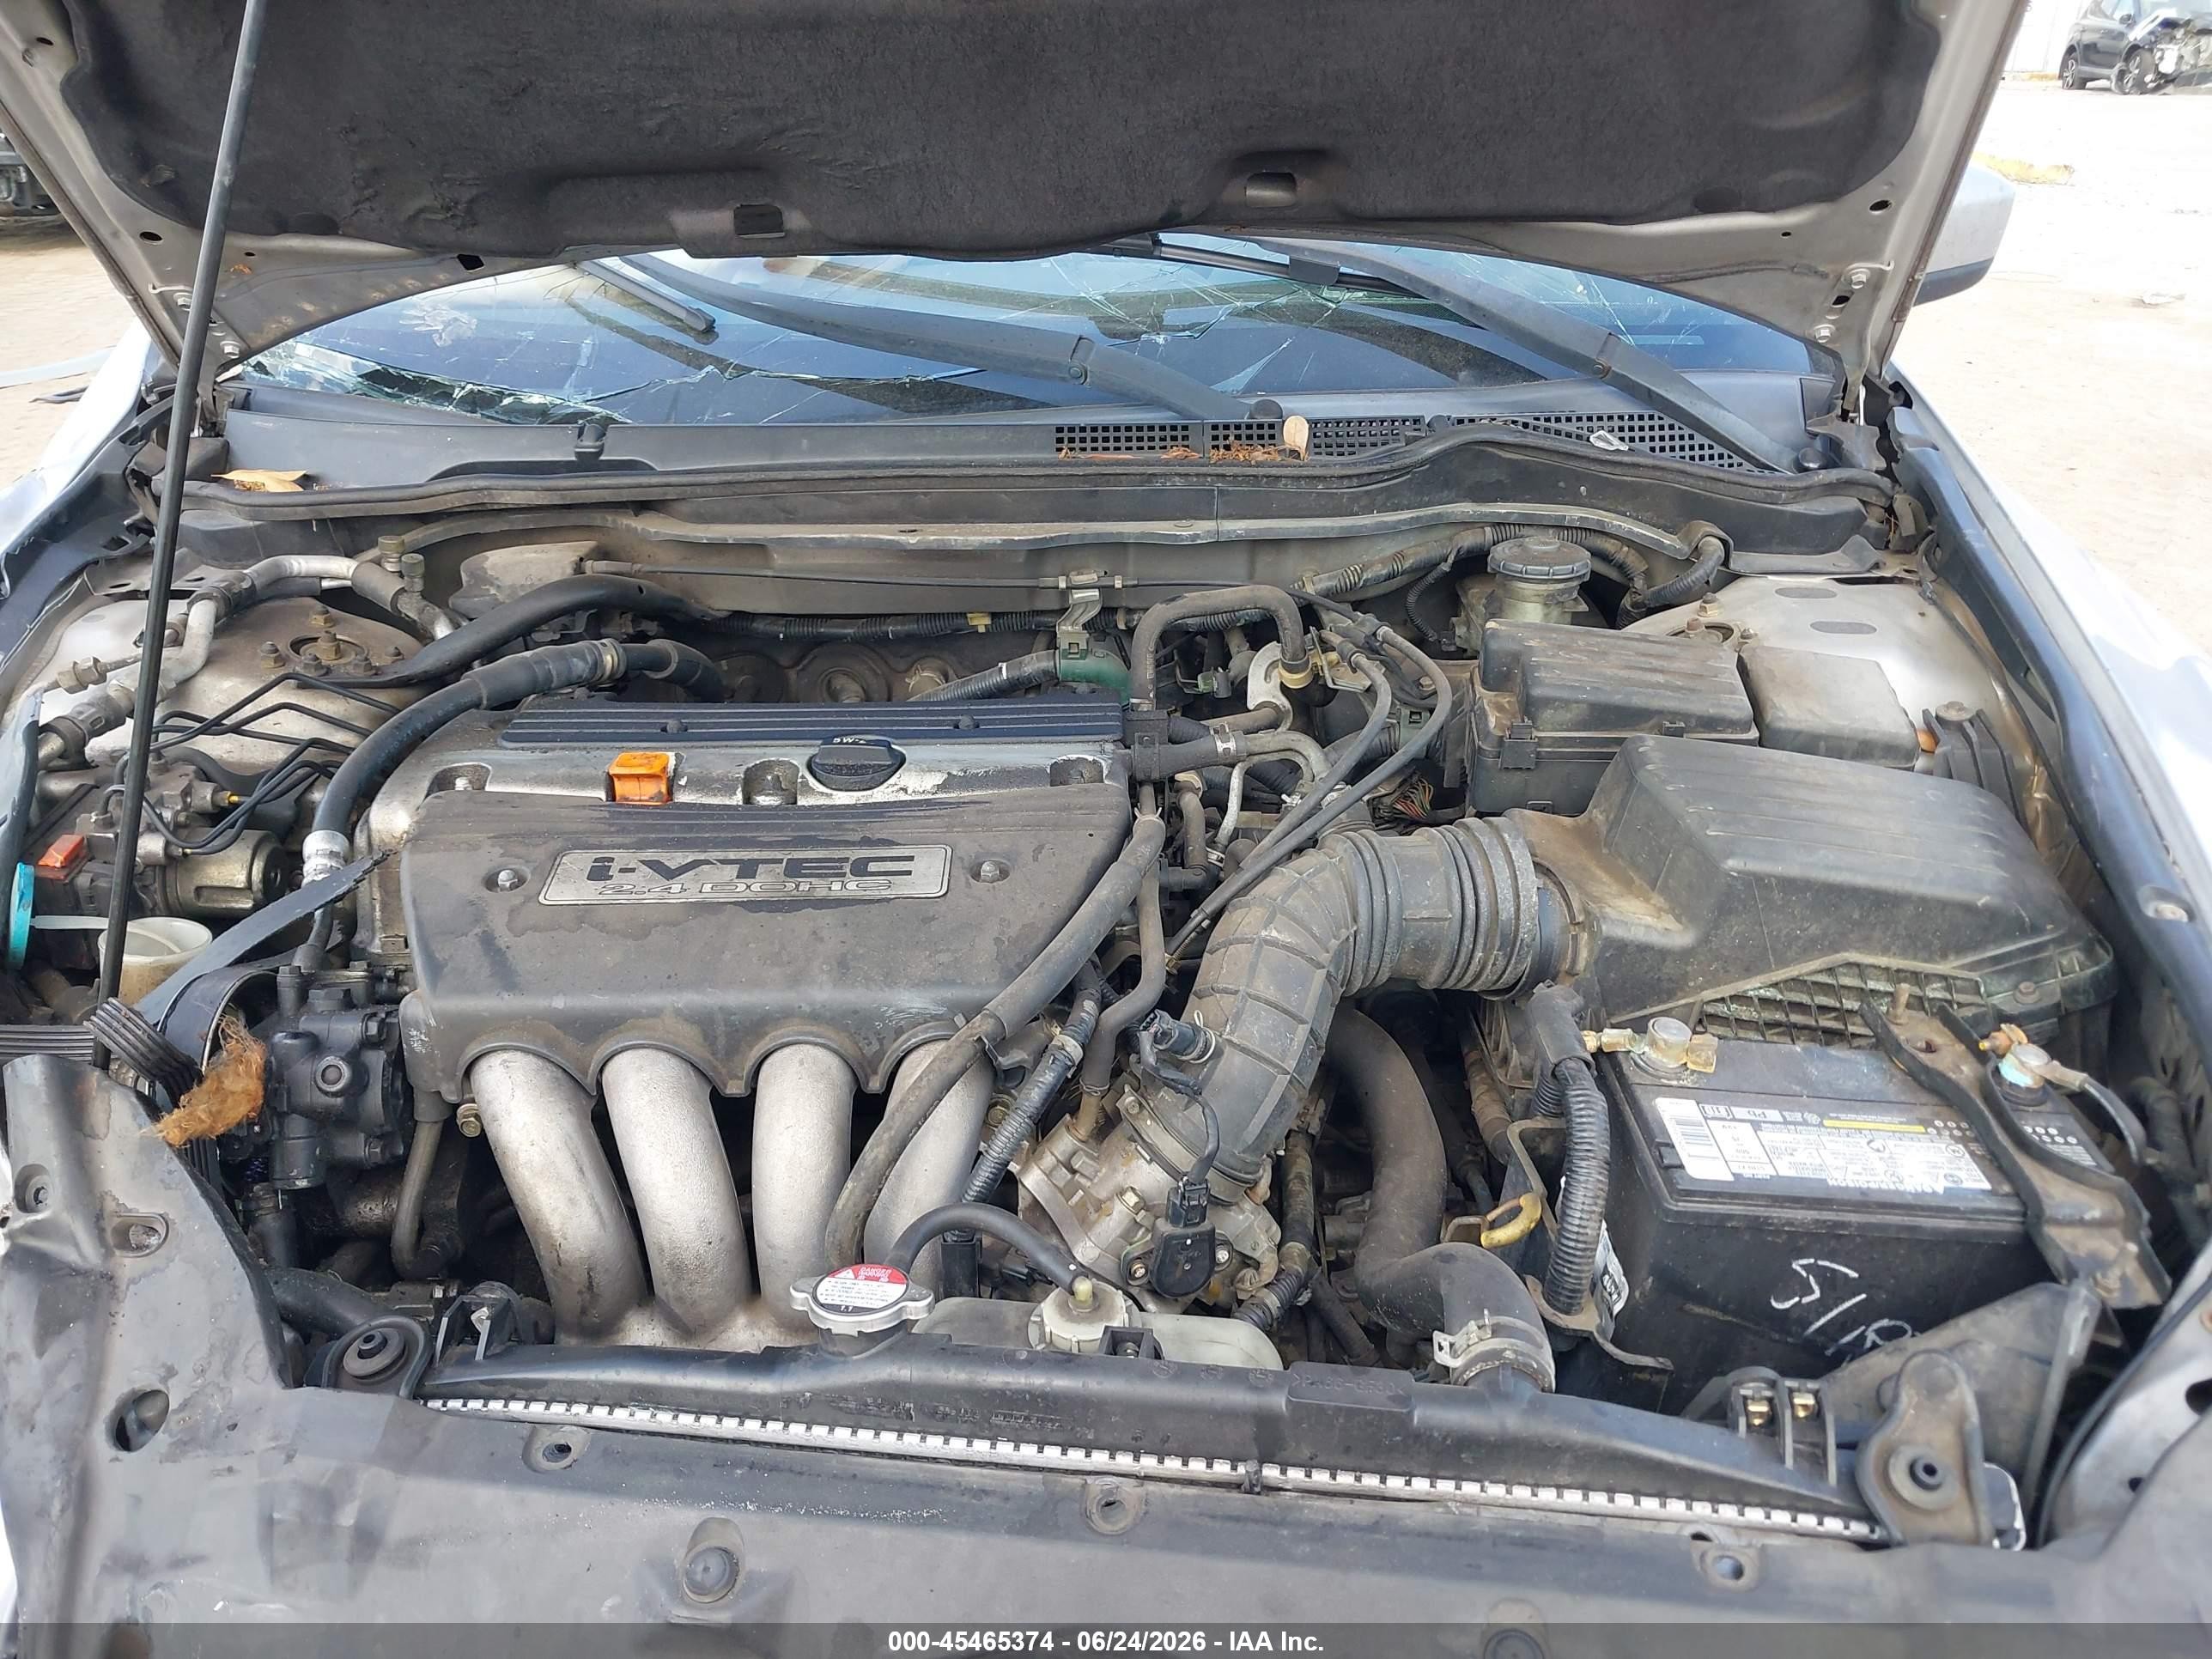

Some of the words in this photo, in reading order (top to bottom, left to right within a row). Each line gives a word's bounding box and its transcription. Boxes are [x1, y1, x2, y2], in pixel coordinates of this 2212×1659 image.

[586, 855, 915, 883] i-VTEC
[599, 882, 689, 896] 2.4
[698, 878, 893, 894] DOHC
